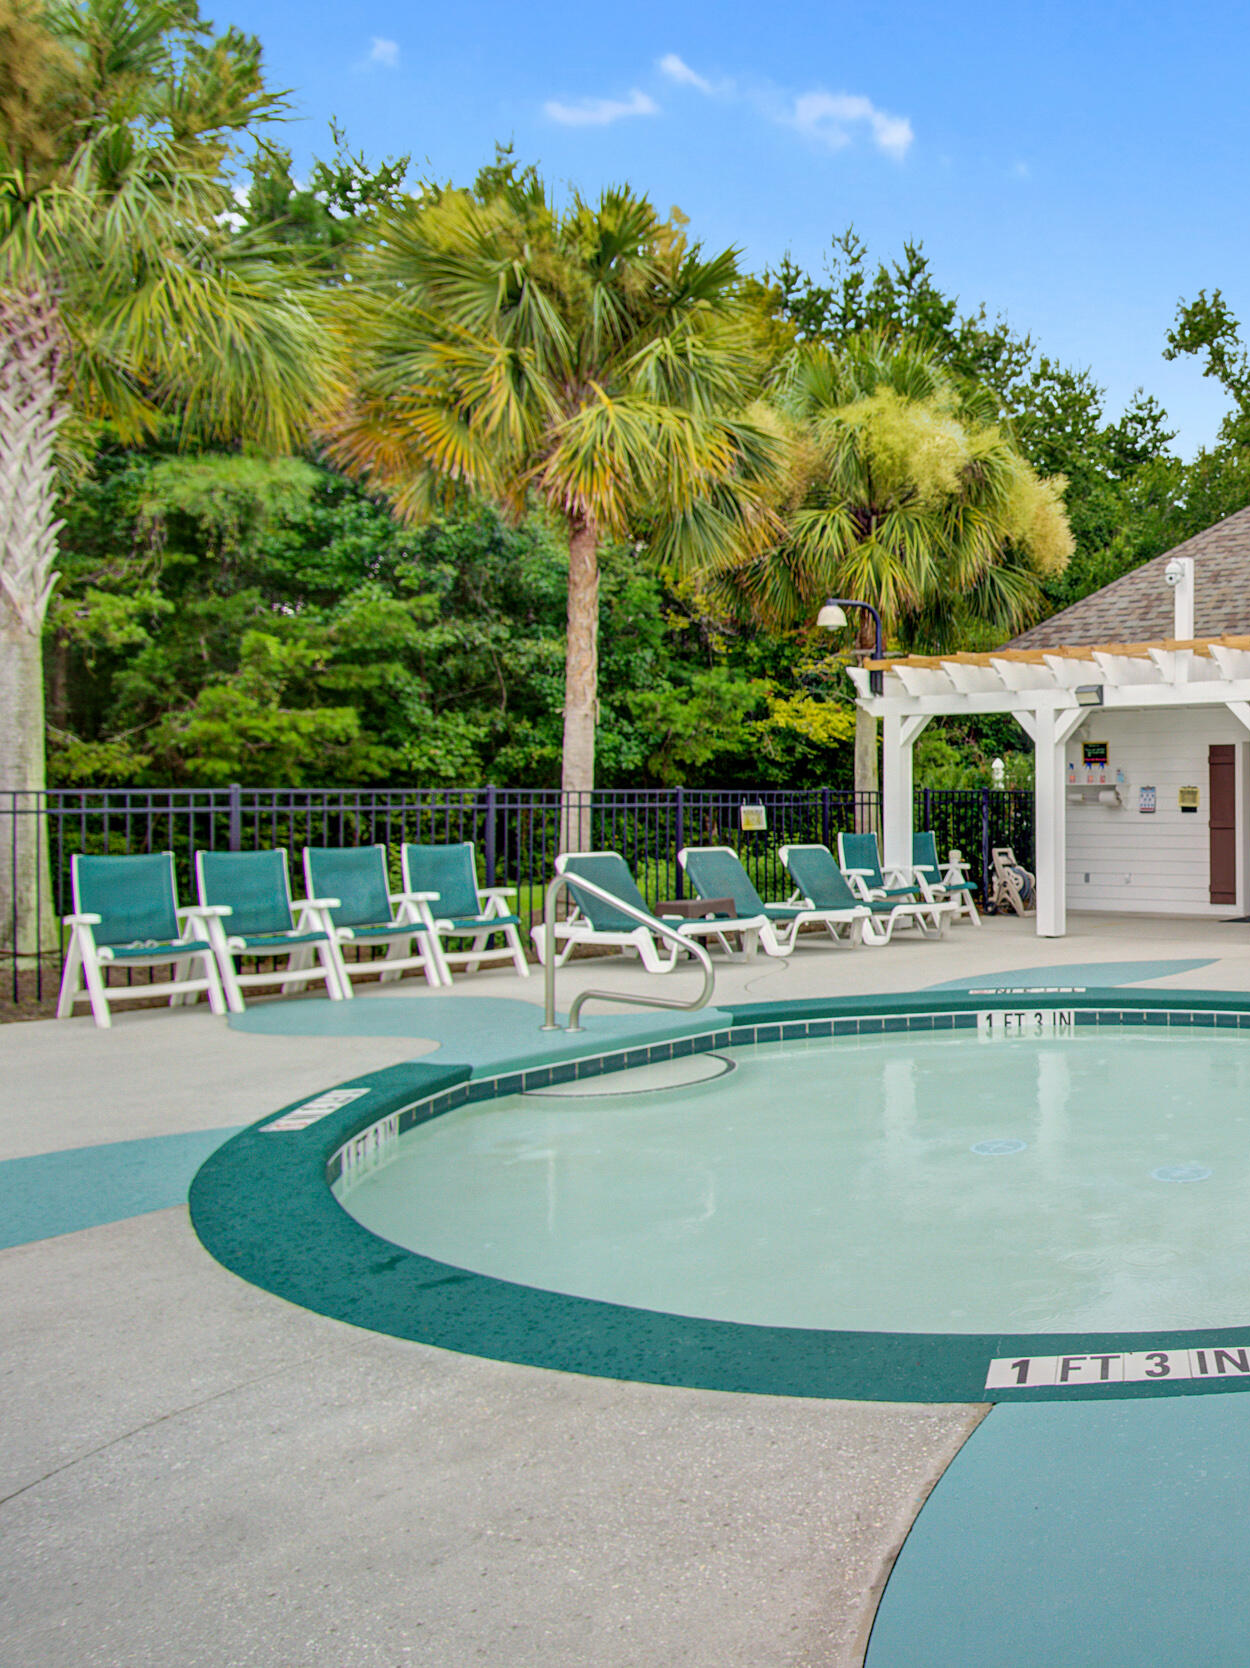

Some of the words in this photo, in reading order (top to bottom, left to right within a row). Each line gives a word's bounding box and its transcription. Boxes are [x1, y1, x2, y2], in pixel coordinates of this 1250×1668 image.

[985, 1013, 993, 1028] 1
[1004, 1012, 1025, 1027] FT
[1053, 1011, 1071, 1026] IN
[1011, 1359, 1031, 1384] 1
[1060, 1355, 1121, 1382] FT
[1145, 1352, 1171, 1378] 3
[1196, 1349, 1250, 1374] IN
